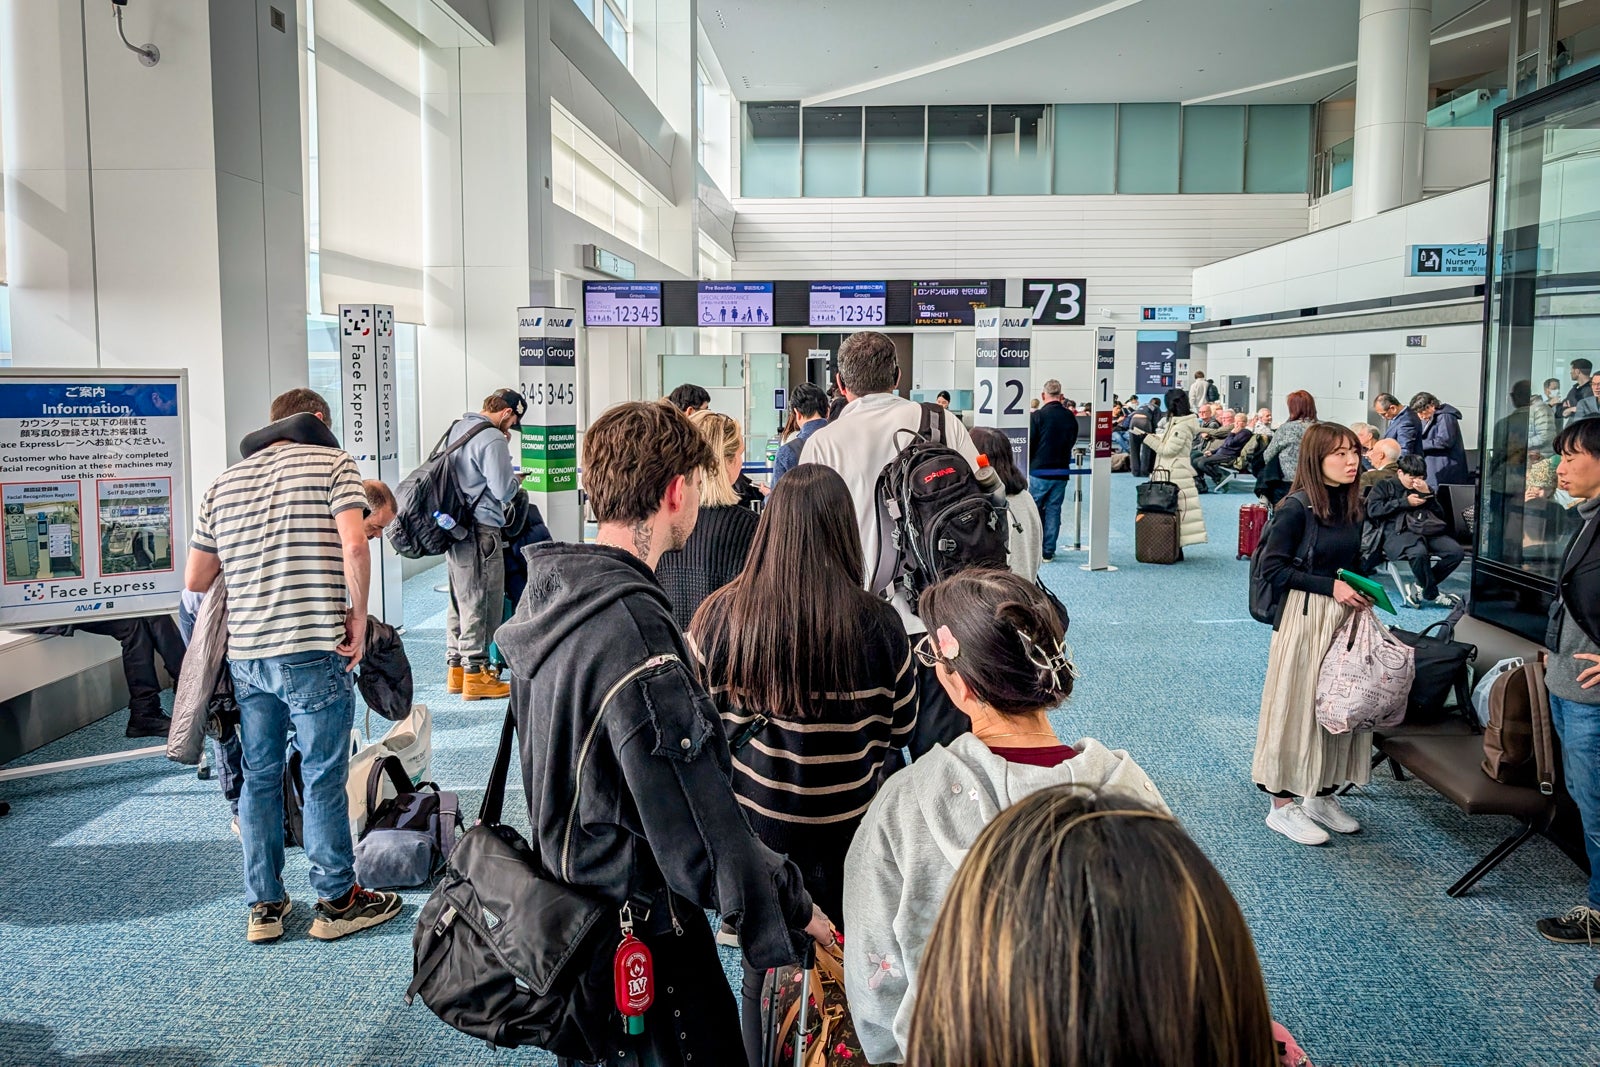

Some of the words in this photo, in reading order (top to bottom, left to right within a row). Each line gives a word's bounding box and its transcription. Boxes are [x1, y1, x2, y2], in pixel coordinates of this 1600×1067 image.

[1446, 258, 1477, 266] Nursery
[1029, 283, 1080, 320] 73
[520, 318, 535, 327] ANA
[547, 319, 564, 327] ANA
[977, 319, 991, 328] ANA
[1002, 319, 1020, 327] ANA
[520, 346, 544, 359] Group
[547, 347, 574, 359] Group
[976, 347, 998, 360] Group
[1000, 347, 1030, 360] Group
[352, 345, 366, 379] Face
[382, 345, 390, 379] Face
[1098, 355, 1114, 365] Group
[66, 386, 105, 398] ご案内
[1100, 378, 1107, 402] 1
[979, 379, 993, 414] 2
[1004, 379, 1024, 414] 2
[42, 403, 129, 414] Information
[350, 384, 366, 443] Express
[382, 384, 391, 442] Express
[20, 418, 147, 428] カウンターにて以下の機械で
[20, 428, 148, 438] 顔写真の登録されたお客様は
[125, 451, 169, 460] completed
[25, 464, 76, 472] recognition
[50, 585, 88, 598] Face
[93, 581, 155, 595] Express
[74, 603, 93, 612] ANA
[629, 978, 647, 996] LV
